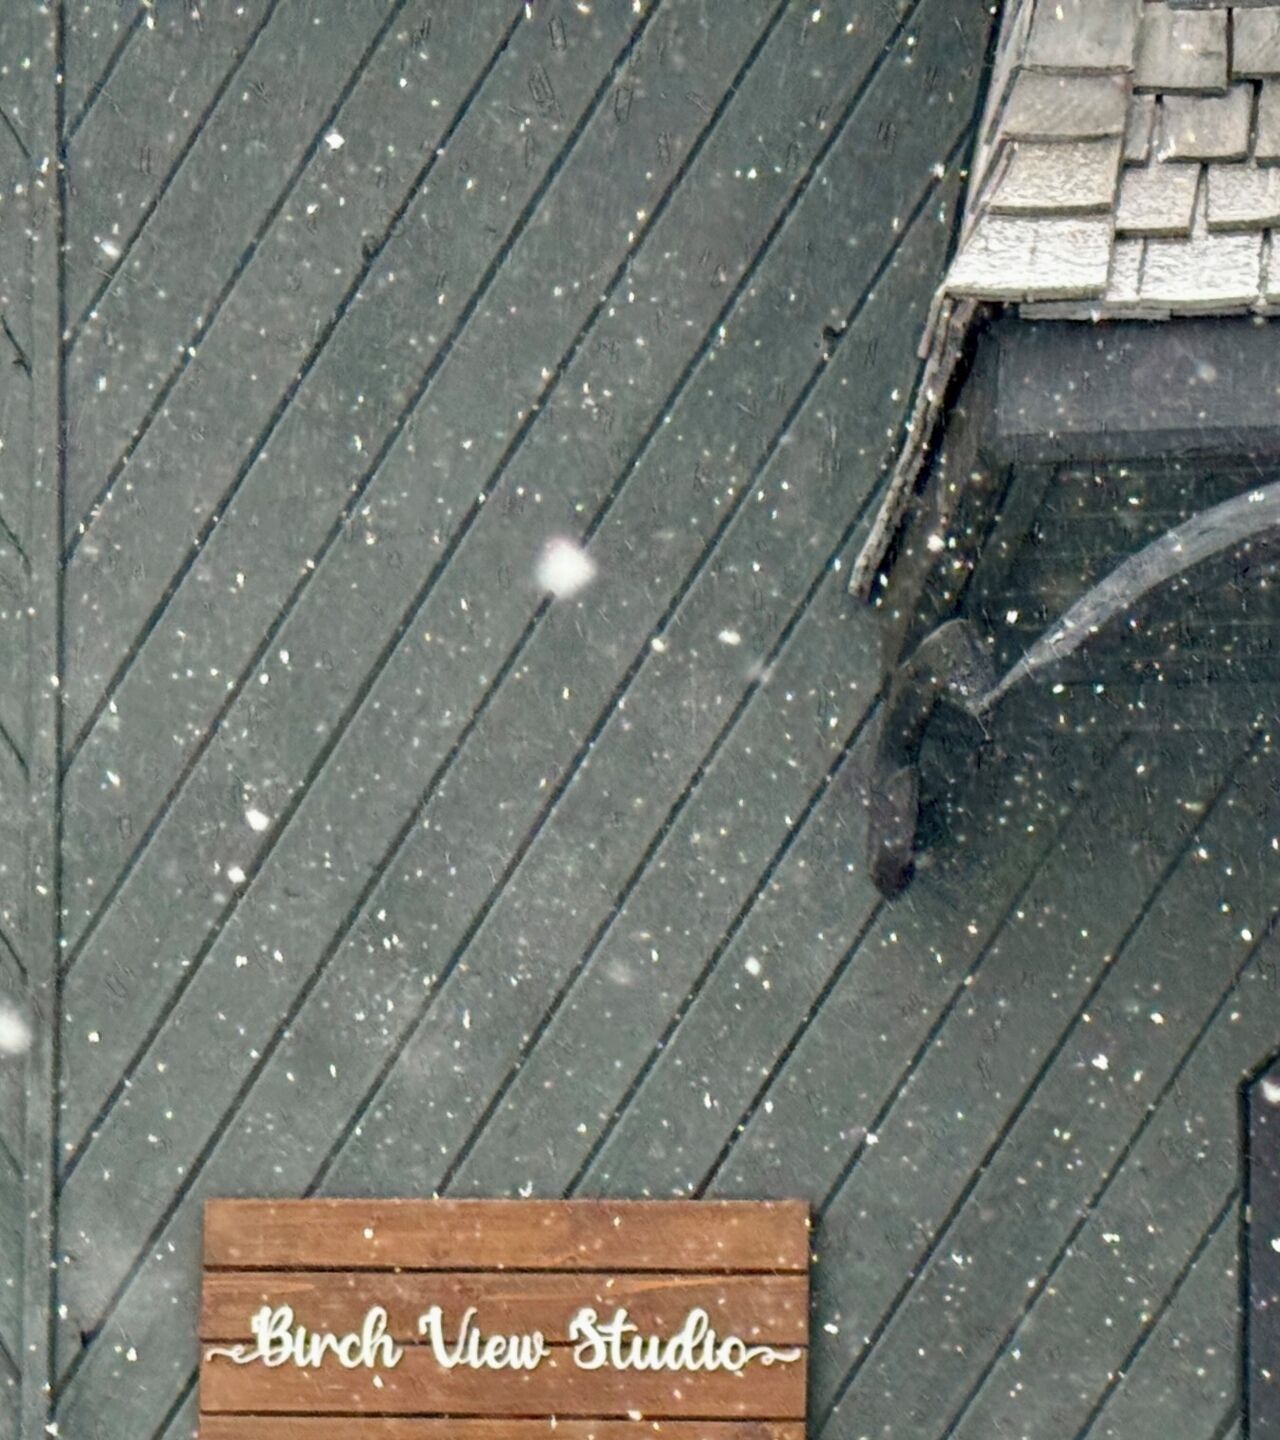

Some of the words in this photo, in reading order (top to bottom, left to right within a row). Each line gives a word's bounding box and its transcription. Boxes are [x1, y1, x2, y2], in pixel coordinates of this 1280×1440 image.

[206, 1304, 403, 1369] Birch
[419, 1305, 548, 1369] View
[568, 1306, 801, 1371] Studio
